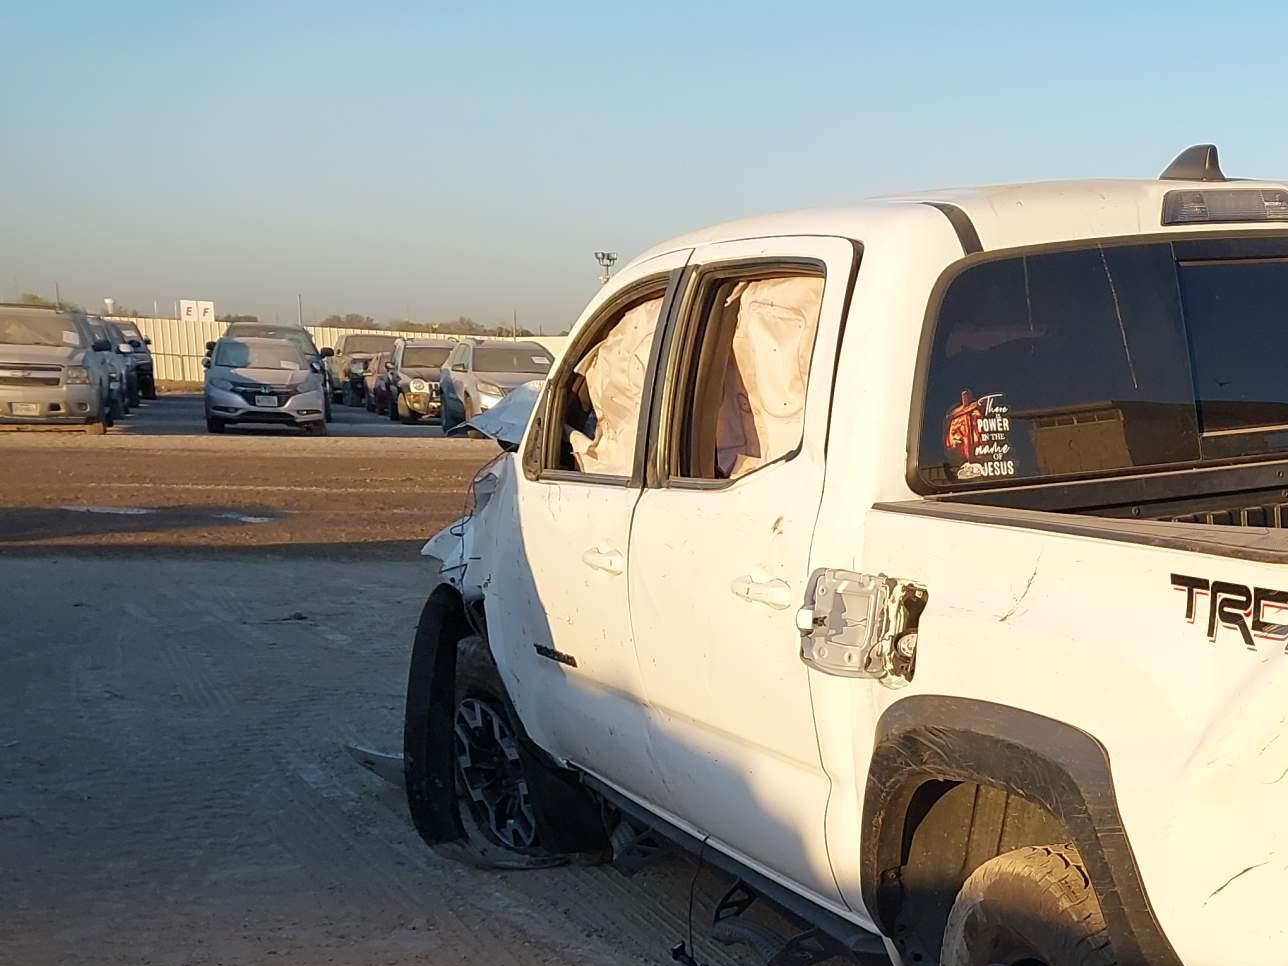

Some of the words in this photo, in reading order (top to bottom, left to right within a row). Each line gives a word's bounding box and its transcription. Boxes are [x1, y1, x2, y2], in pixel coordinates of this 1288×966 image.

[186, 306, 192, 316] E
[203, 307, 209, 317] F
[978, 394, 1008, 416] There
[977, 418, 1009, 432] POWER
[981, 433, 990, 441] IN
[991, 433, 1006, 441] THE
[975, 442, 1010, 456] name
[982, 461, 1014, 476] JESUS
